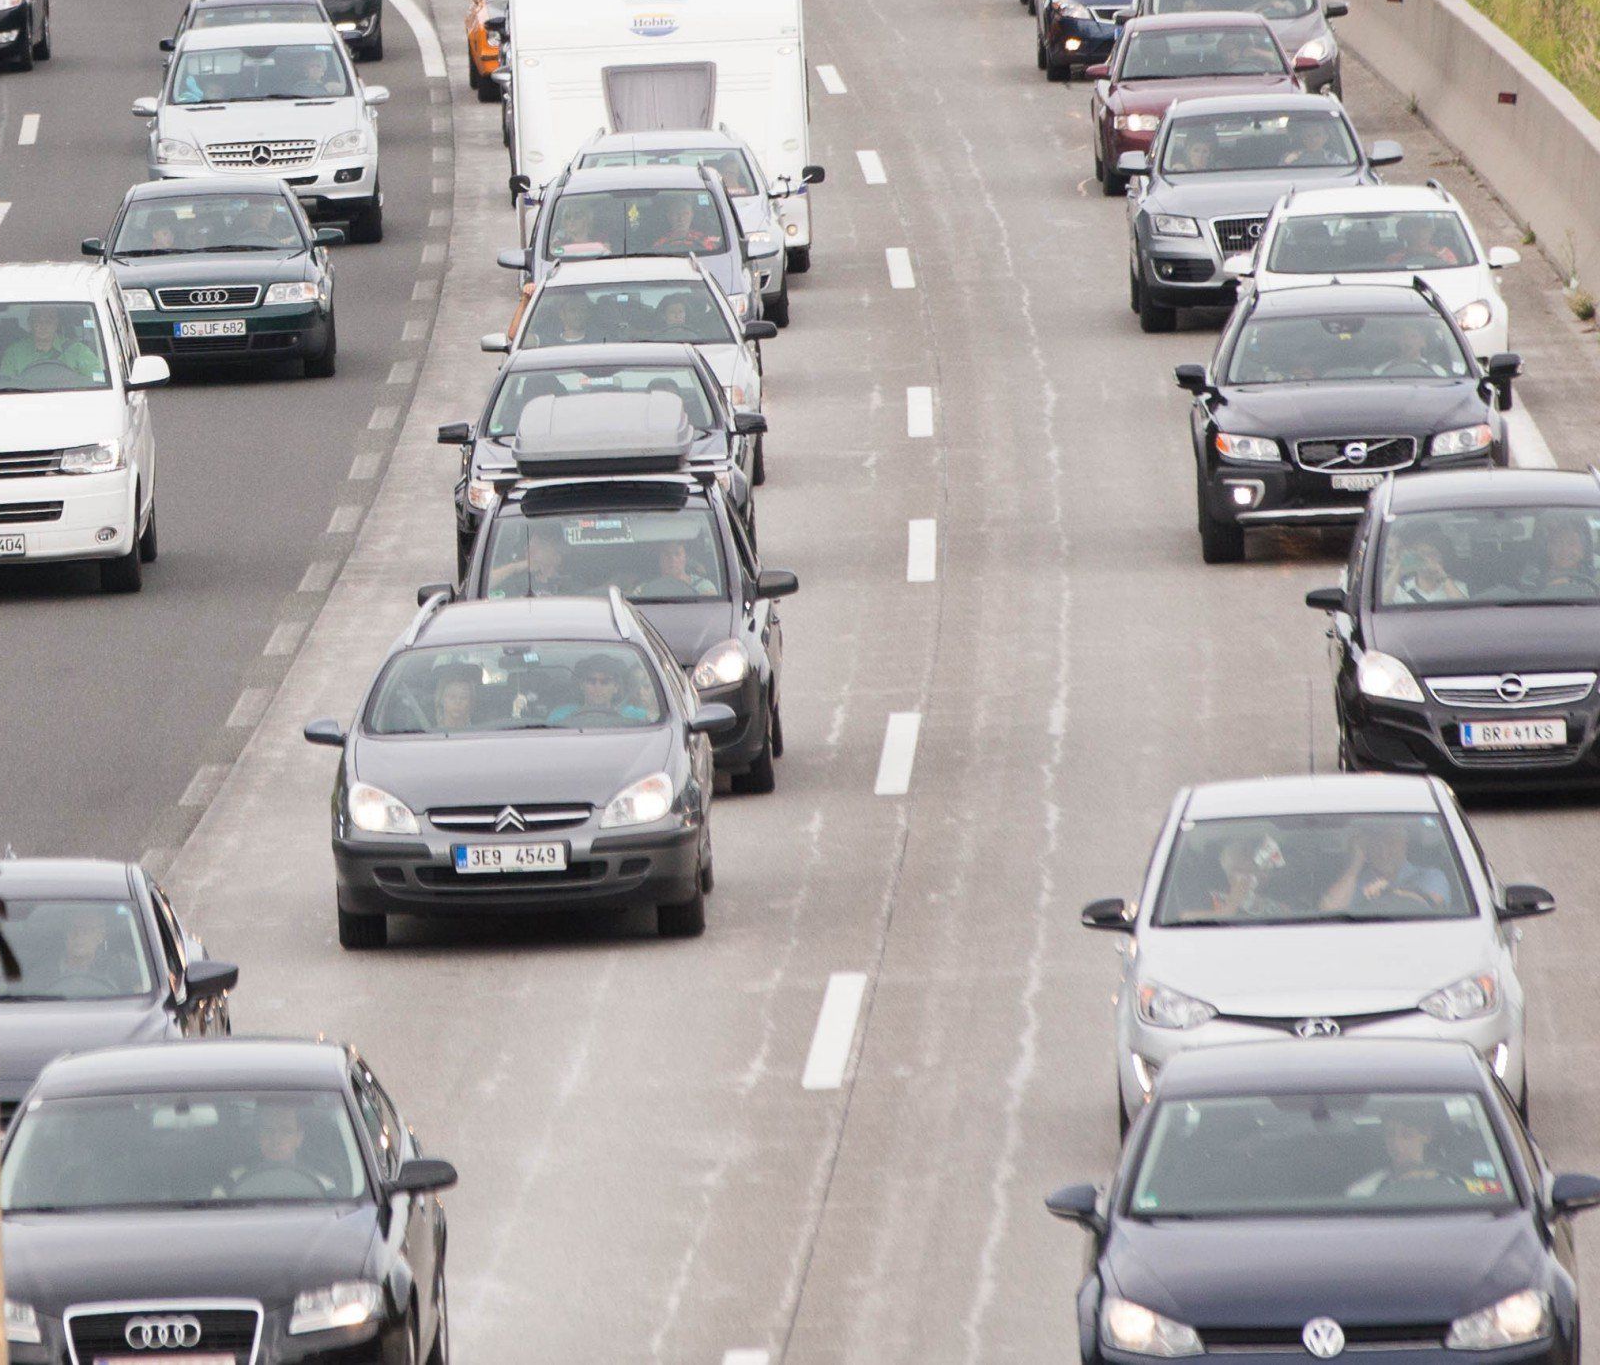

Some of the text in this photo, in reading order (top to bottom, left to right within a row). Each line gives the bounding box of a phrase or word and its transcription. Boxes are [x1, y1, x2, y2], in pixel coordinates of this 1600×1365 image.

[633, 17, 676, 29] Hobby
[182, 322, 245, 336] OS UF 682
[1481, 727, 1502, 741] BR
[472, 847, 557, 866] 3E9 4549
